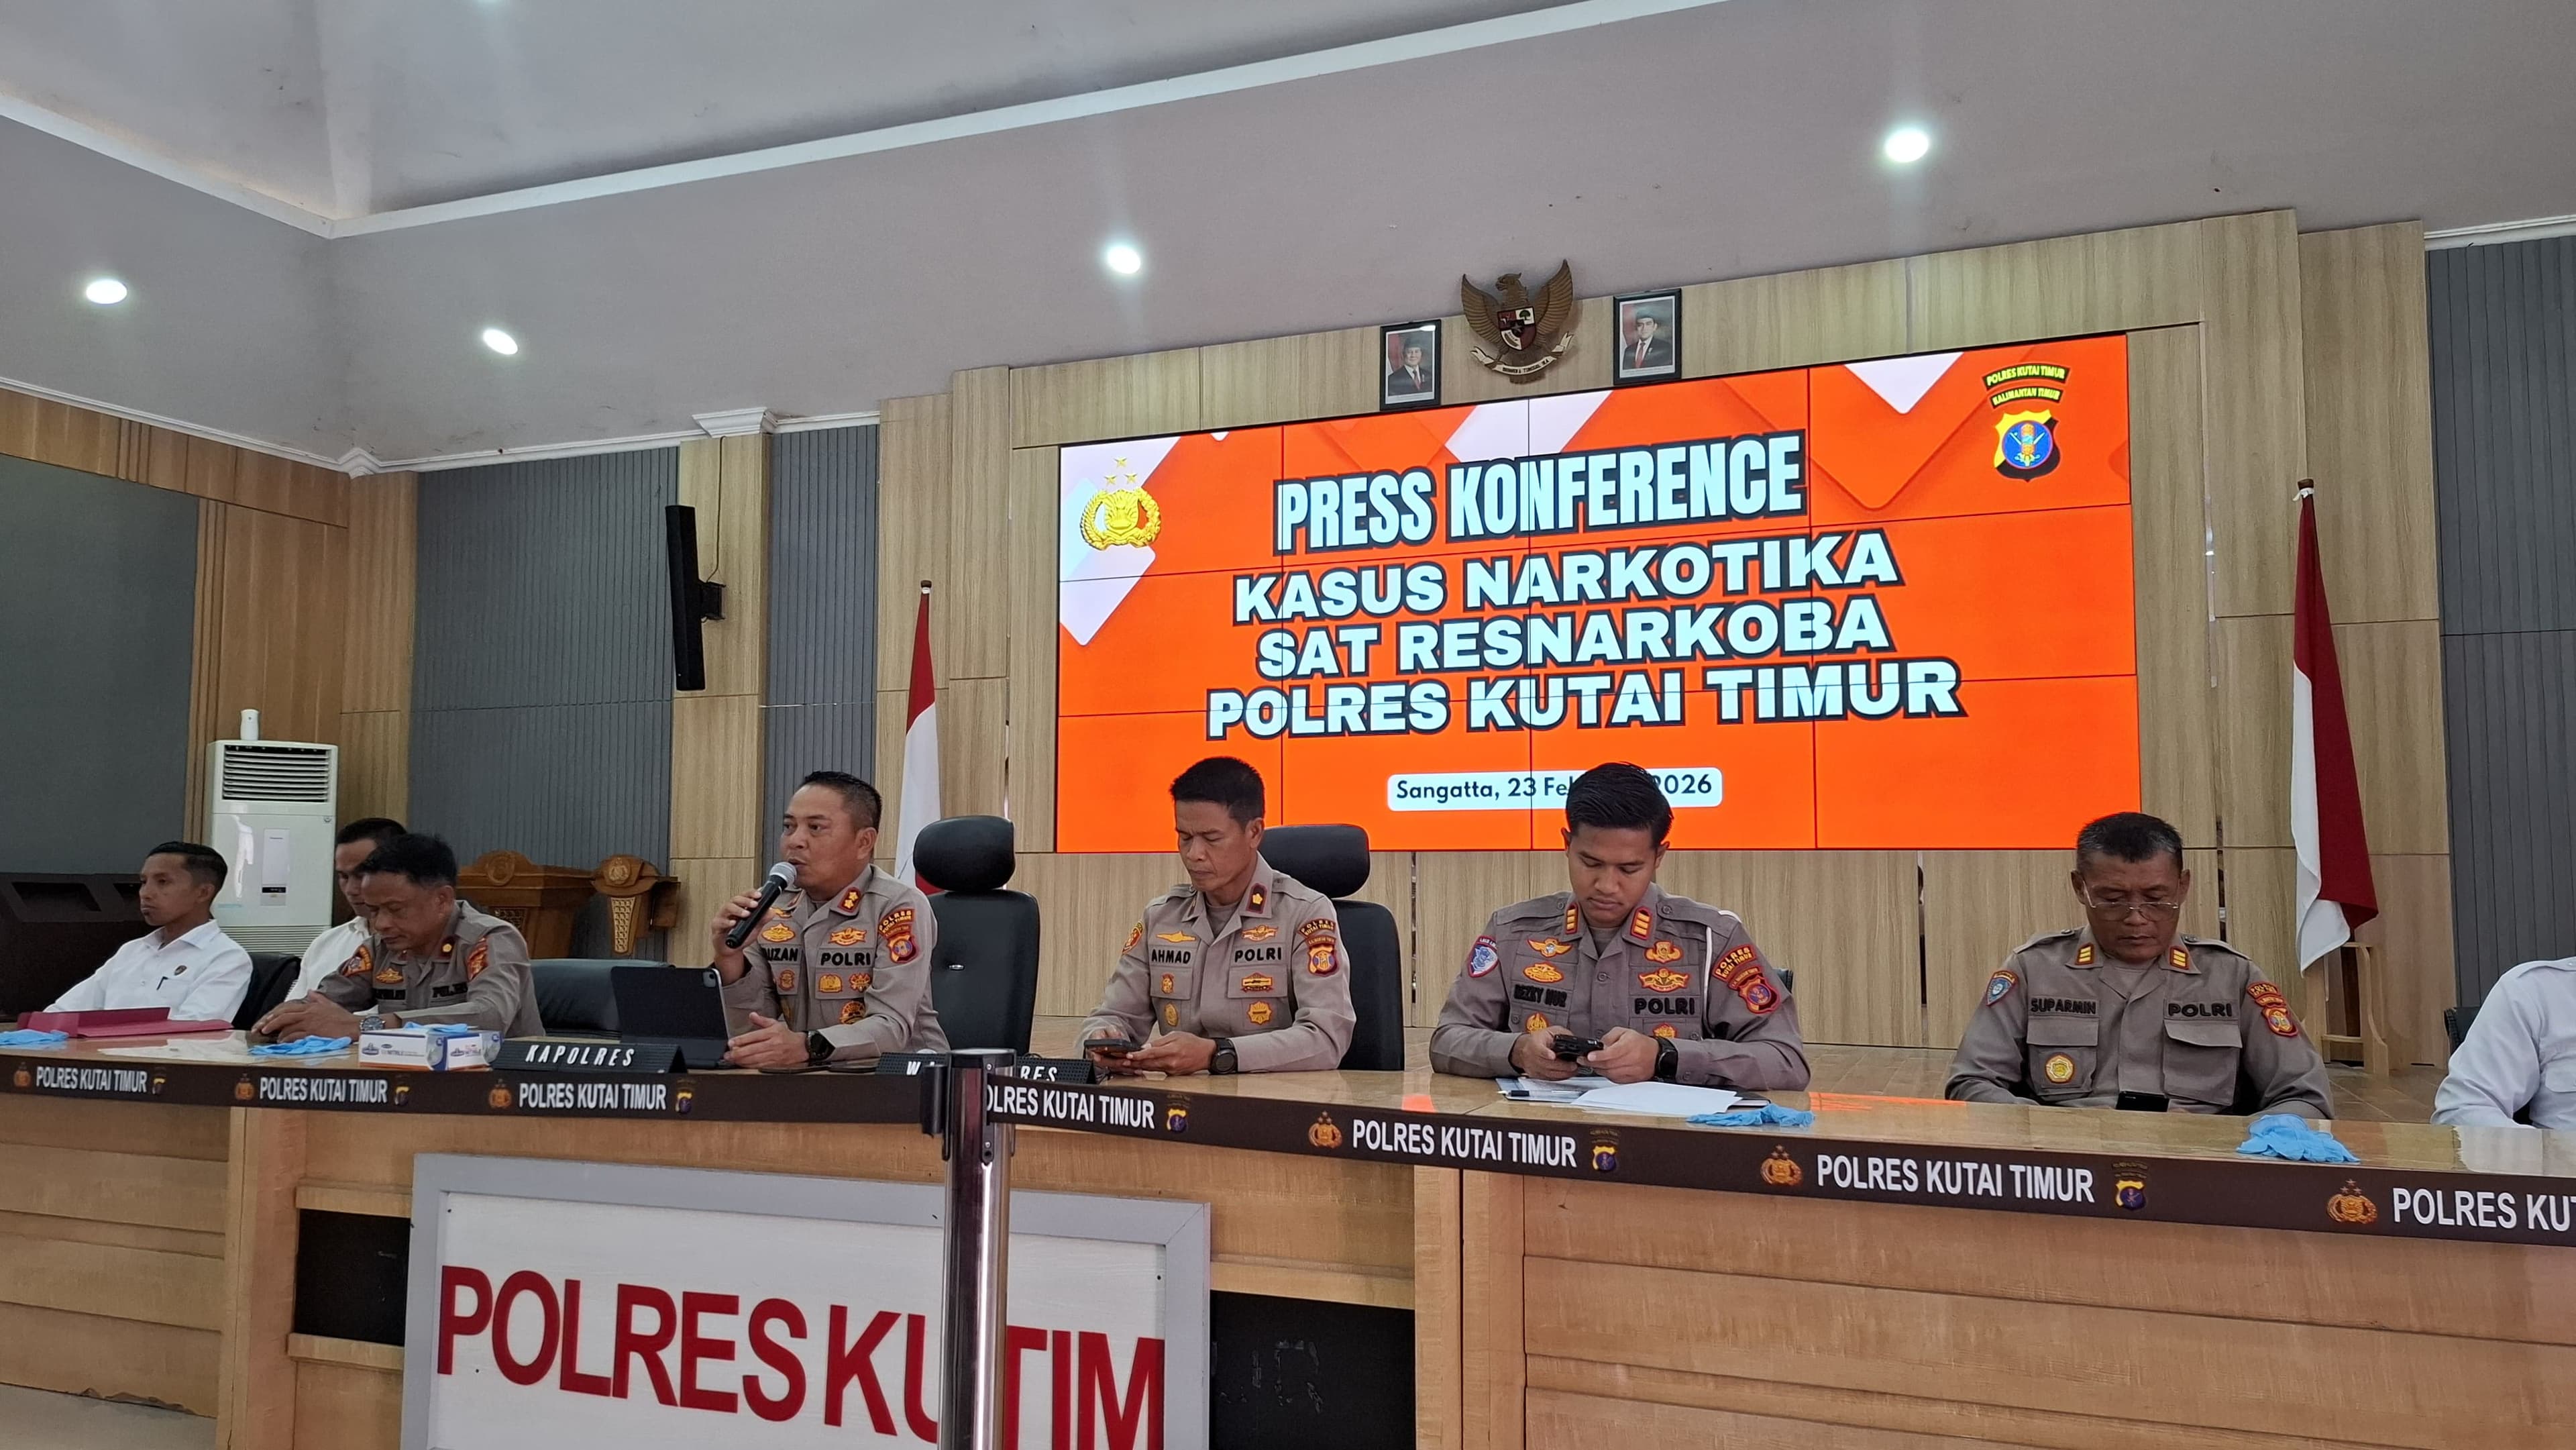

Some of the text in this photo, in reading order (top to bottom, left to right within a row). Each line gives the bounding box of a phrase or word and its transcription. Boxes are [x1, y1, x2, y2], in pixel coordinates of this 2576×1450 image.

[1986, 365, 2065, 386] POLRES KUTAI TIMUR
[1277, 435, 1803, 552] PRESS KONFERENCE
[1234, 532, 1899, 624] KASUS NARKOTIKA
[1258, 598, 1890, 678] SAT RESNARKOBA
[1208, 662, 1960, 741] POLRES KUTAI TIMUR
[1397, 780, 1499, 804] Sangatta,
[1508, 778, 1536, 796] 23
[820, 952, 871, 966] POLRI
[1151, 949, 1191, 964] AHMAD
[1235, 947, 1282, 963] POLRI
[1715, 947, 1750, 976] POLRES
[1635, 998, 1695, 1015] POLRI
[2031, 998, 2096, 1014] SUPARMIN
[2168, 1003, 2233, 1017] POLRI
[525, 1045, 635, 1066] KAPOLRES
[36, 1066, 147, 1092] POLRES KUTAI TIMUR
[260, 1077, 388, 1103] POLRES KUTAI TIMUR
[519, 1083, 666, 1110] POLRES KUTAI TIMUR
[987, 1084, 1155, 1129] LRES KUTAI TIMUR
[1352, 1119, 1435, 1155] POLRES
[1441, 1126, 1502, 1161] KUTAI
[1508, 1132, 1577, 1168] TIMUR
[1817, 1154, 1919, 1192] POLRES
[1926, 1159, 2002, 1197] KUTAI
[2008, 1165, 2095, 1203] TIMUR
[2392, 1187, 2517, 1229] POLRES
[436, 1265, 808, 1422] POLRES
